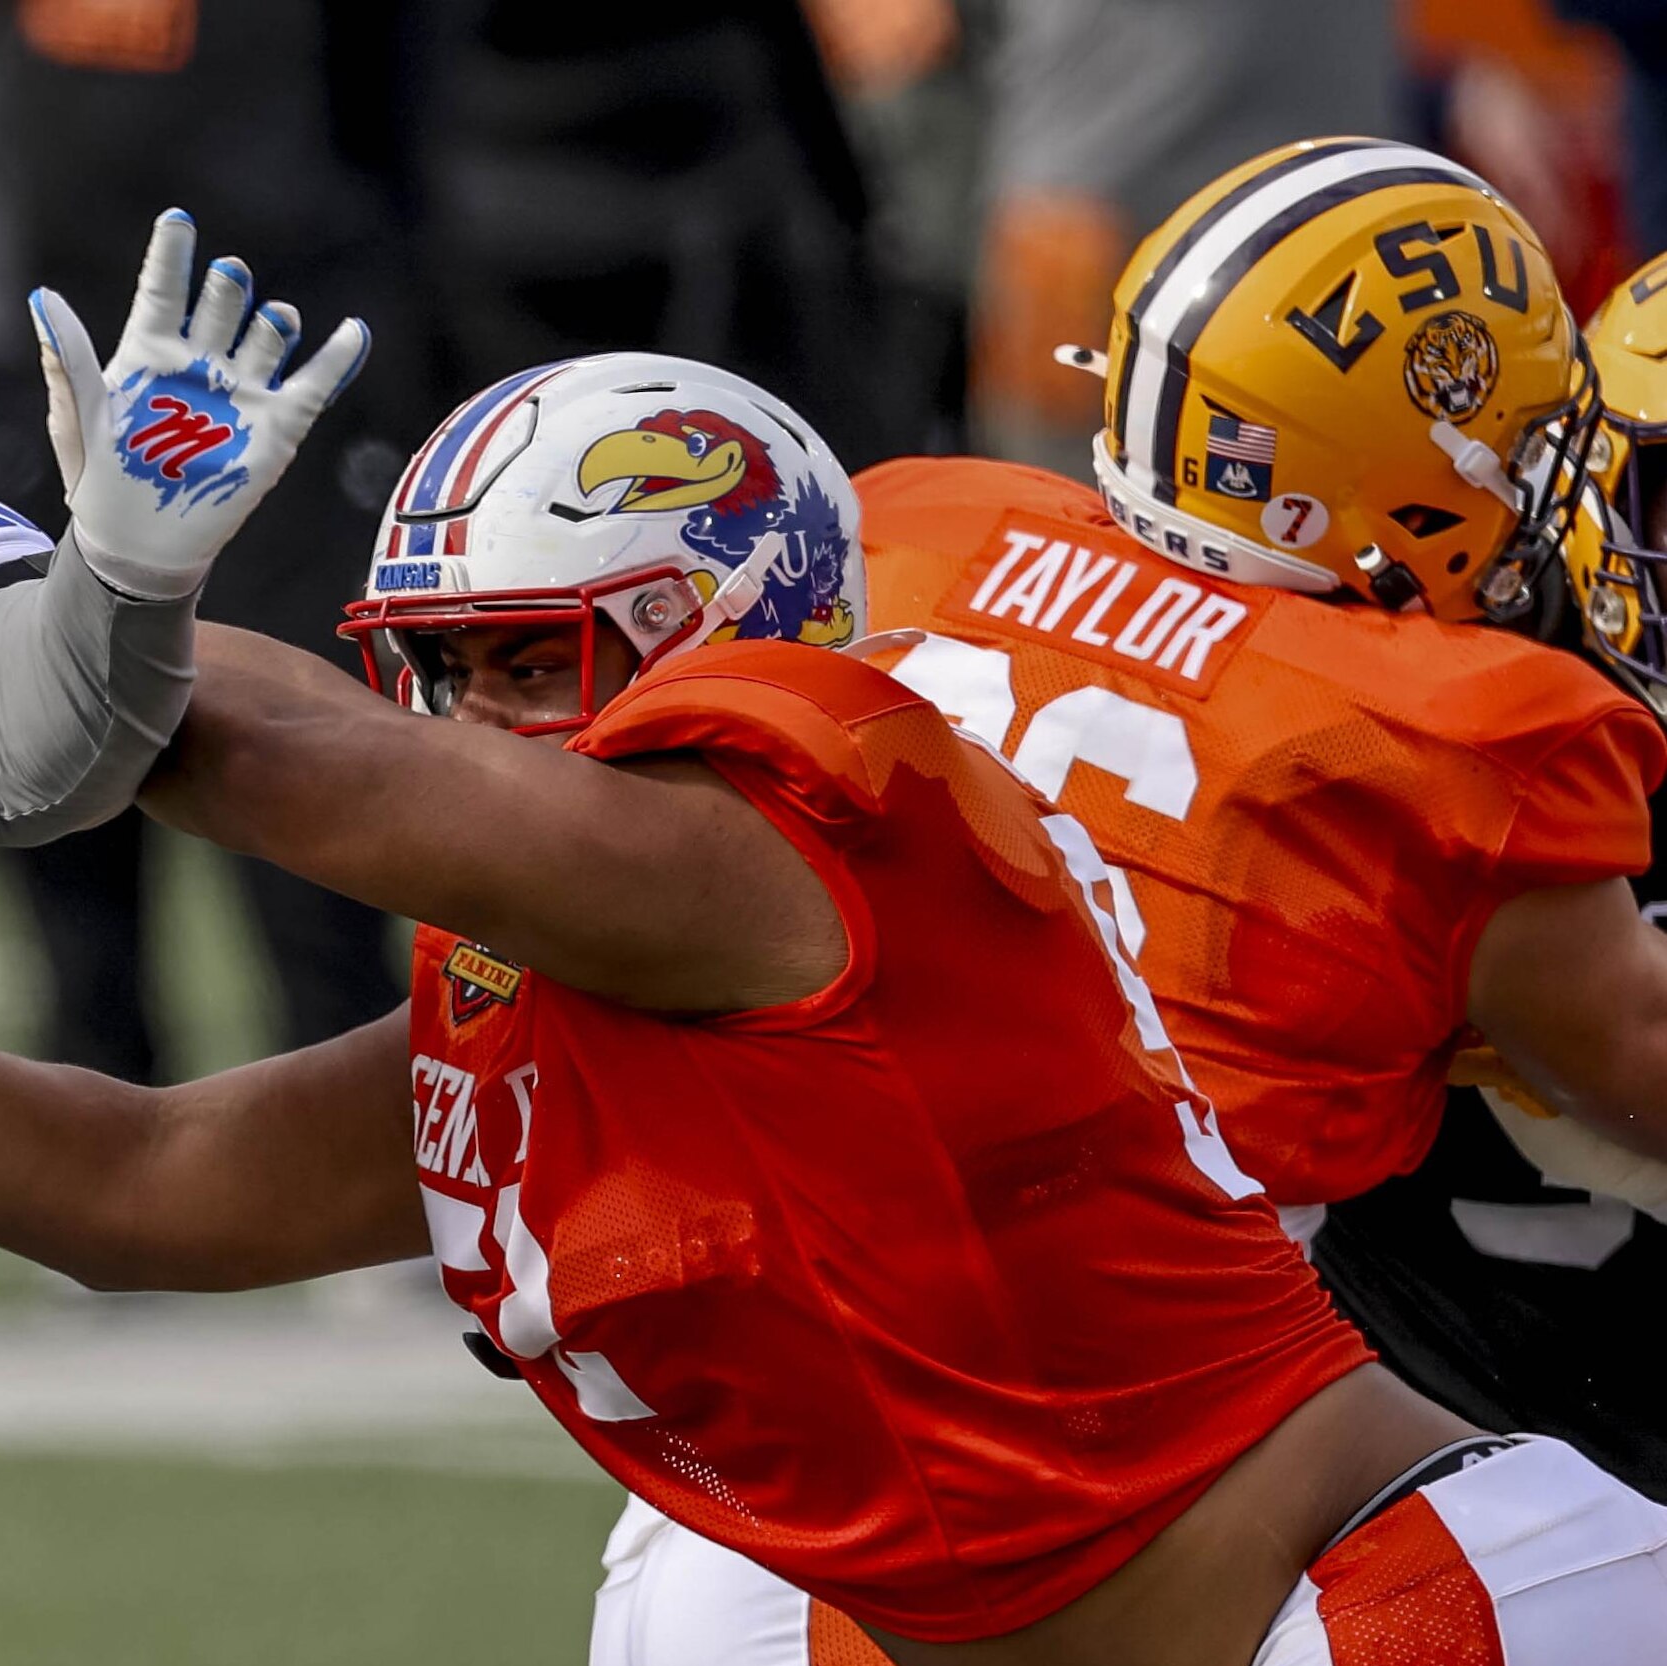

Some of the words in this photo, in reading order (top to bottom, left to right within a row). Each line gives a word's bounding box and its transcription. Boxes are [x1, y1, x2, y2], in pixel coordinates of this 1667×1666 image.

[1283, 219, 1529, 374] LSU
[1183, 457, 1198, 487] 6
[1281, 497, 1312, 544] 7
[375, 562, 441, 591] KANSAS
[969, 528, 1249, 682] TAYLOR
[452, 951, 517, 991] PANINI
